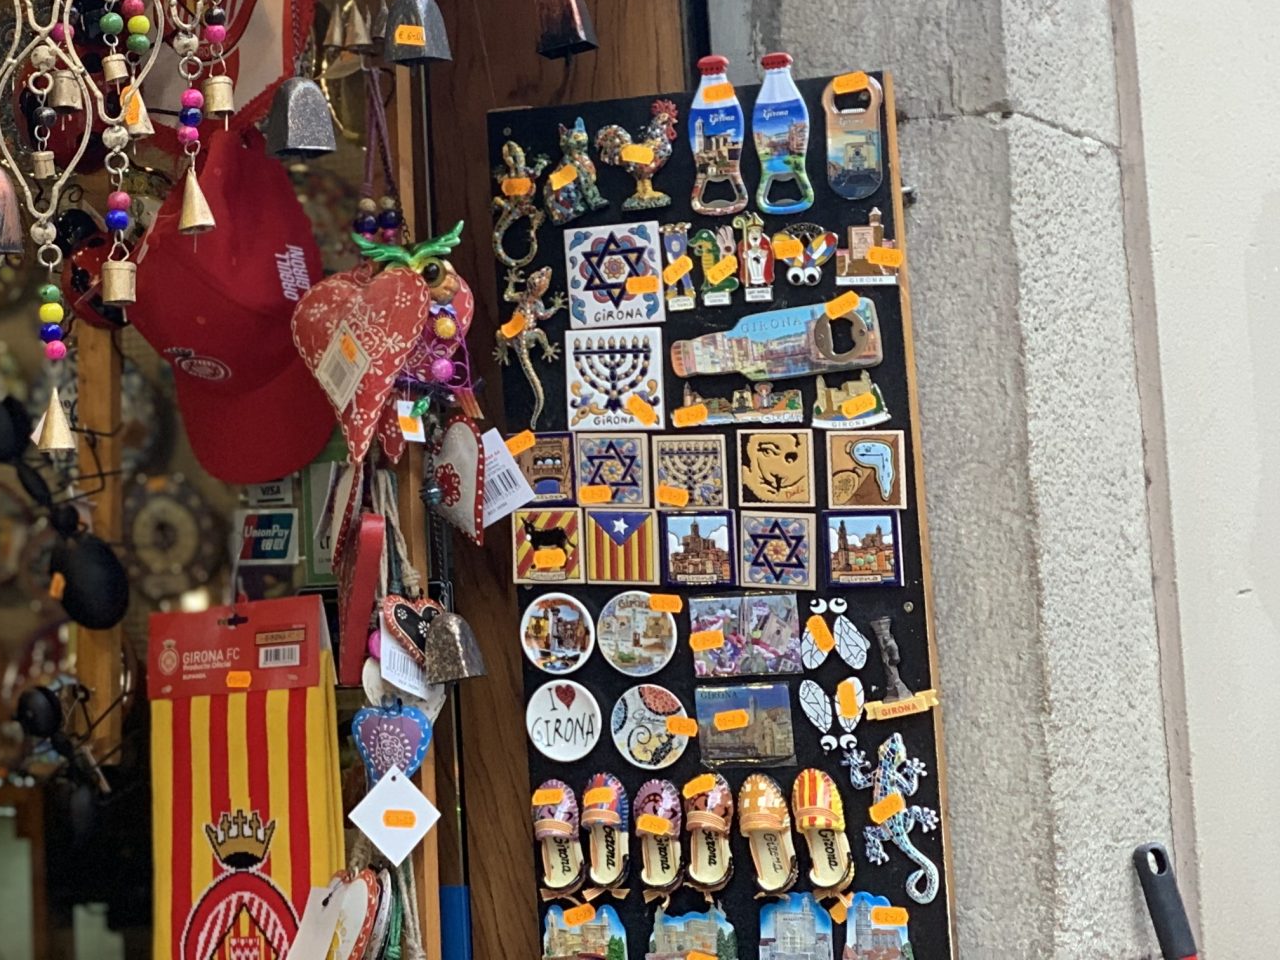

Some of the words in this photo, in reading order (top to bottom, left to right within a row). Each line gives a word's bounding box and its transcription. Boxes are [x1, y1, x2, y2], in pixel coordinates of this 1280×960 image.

[274, 251, 300, 302] ORGULL
[594, 308, 644, 323] GIRONA
[740, 315, 803, 334] GIRONA
[593, 416, 635, 426] GIRONA
[832, 420, 868, 429] GIRONA
[260, 485, 281, 497] VISA
[244, 524, 290, 542] UnionPay
[183, 649, 224, 664] GIRONA
[226, 647, 241, 660] FC
[700, 690, 738, 700] GIRONA
[880, 703, 918, 717] GIRONA
[531, 712, 596, 748] GIRONA
[818, 828, 840, 872] Girona
